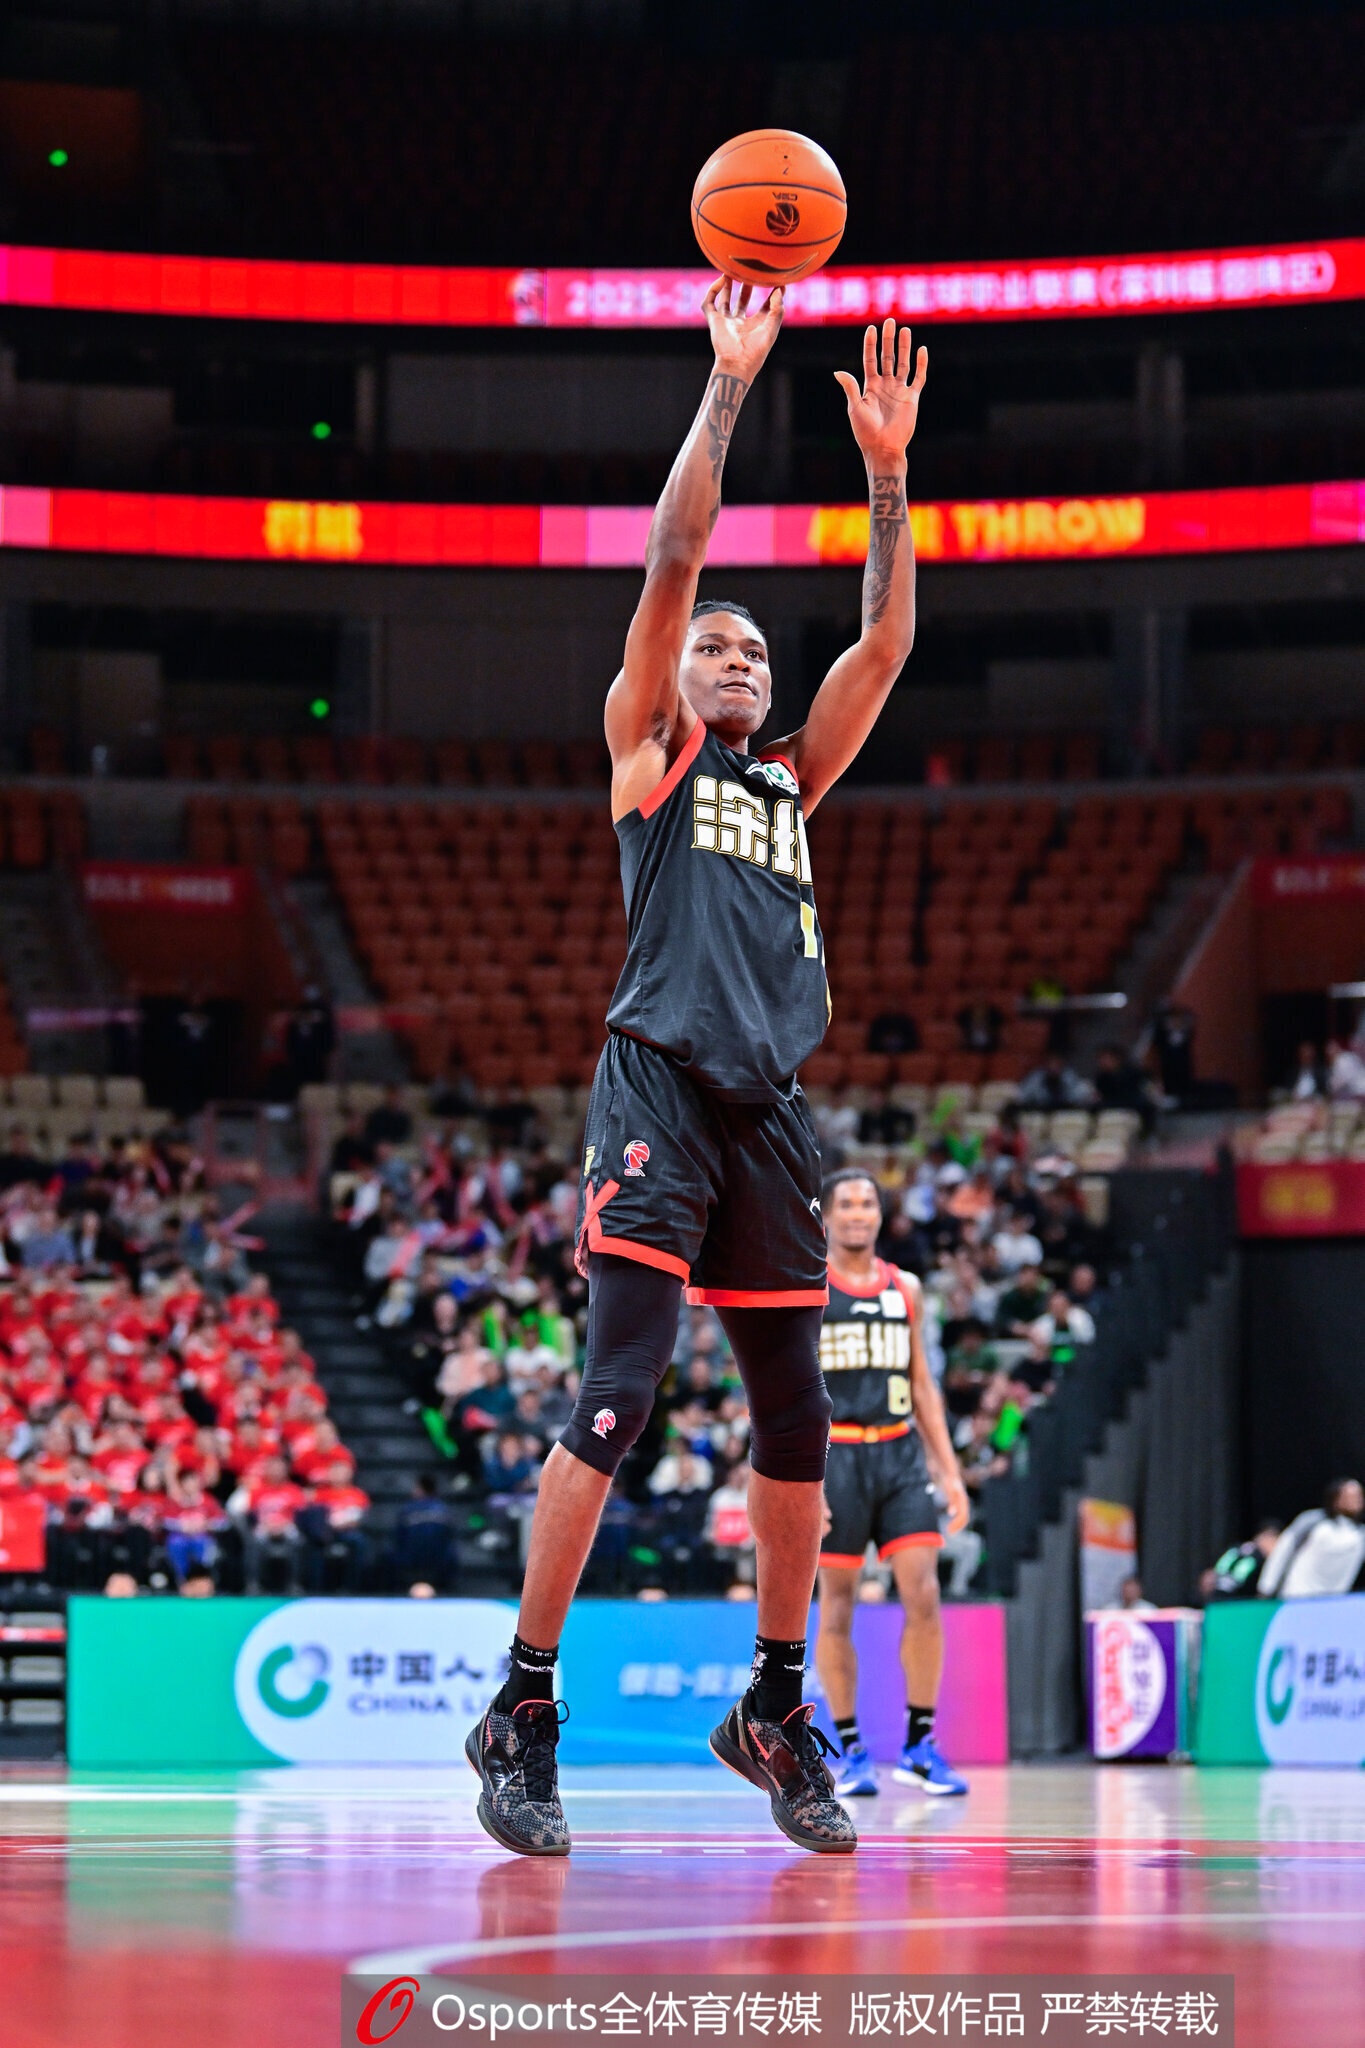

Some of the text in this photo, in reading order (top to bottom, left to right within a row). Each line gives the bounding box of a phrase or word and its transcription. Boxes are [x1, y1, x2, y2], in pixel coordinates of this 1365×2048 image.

[950, 498, 1146, 559] THROW
[820, 1321, 911, 1371] 深圳
[348, 1693, 453, 1716] CHINA
